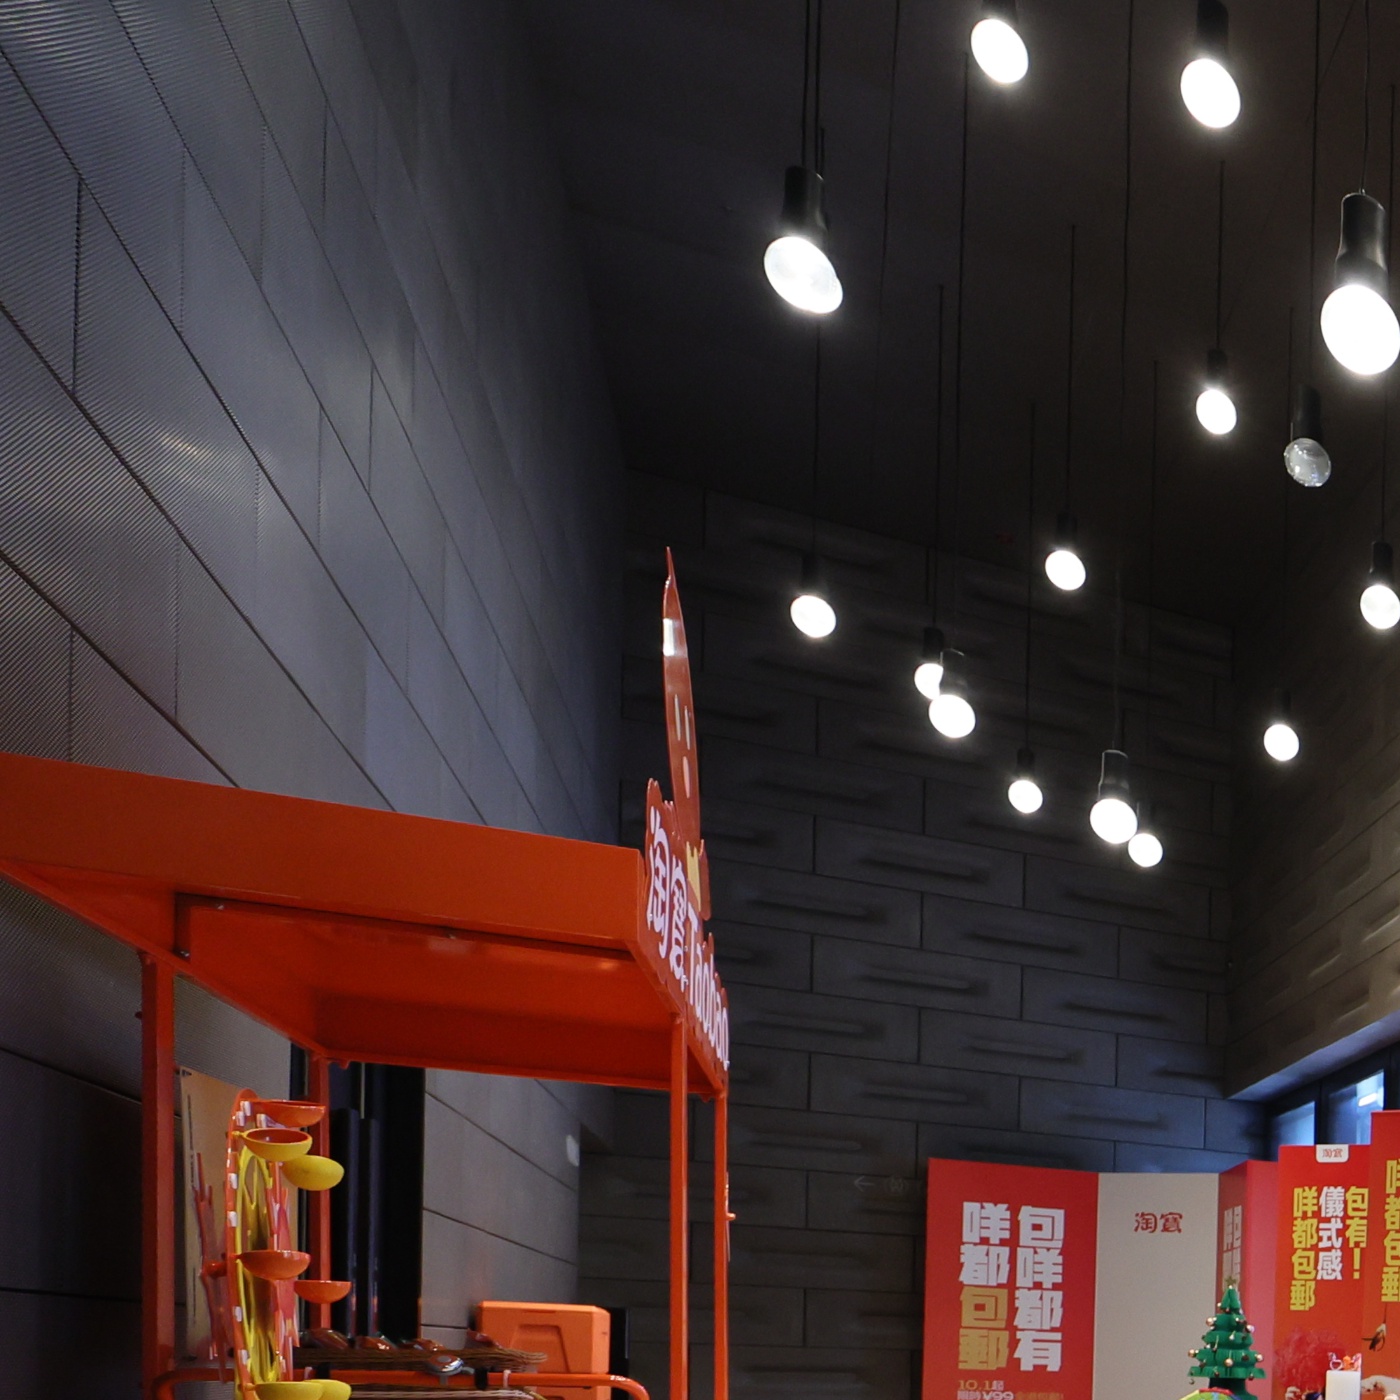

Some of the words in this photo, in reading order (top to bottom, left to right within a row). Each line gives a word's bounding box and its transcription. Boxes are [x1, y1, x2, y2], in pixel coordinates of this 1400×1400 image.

[646, 805, 688, 992] 淘寶
[687, 901, 730, 1071] Taobao
[957, 1201, 1011, 1371] 咩都包郵
[1013, 1205, 1065, 1372] 包咩都有
[1134, 1212, 1184, 1234] 淘寶
[1290, 1186, 1318, 1311] 咩都包郵
[1316, 1186, 1345, 1281] 儀式感
[1345, 1186, 1369, 1280] 包有!
